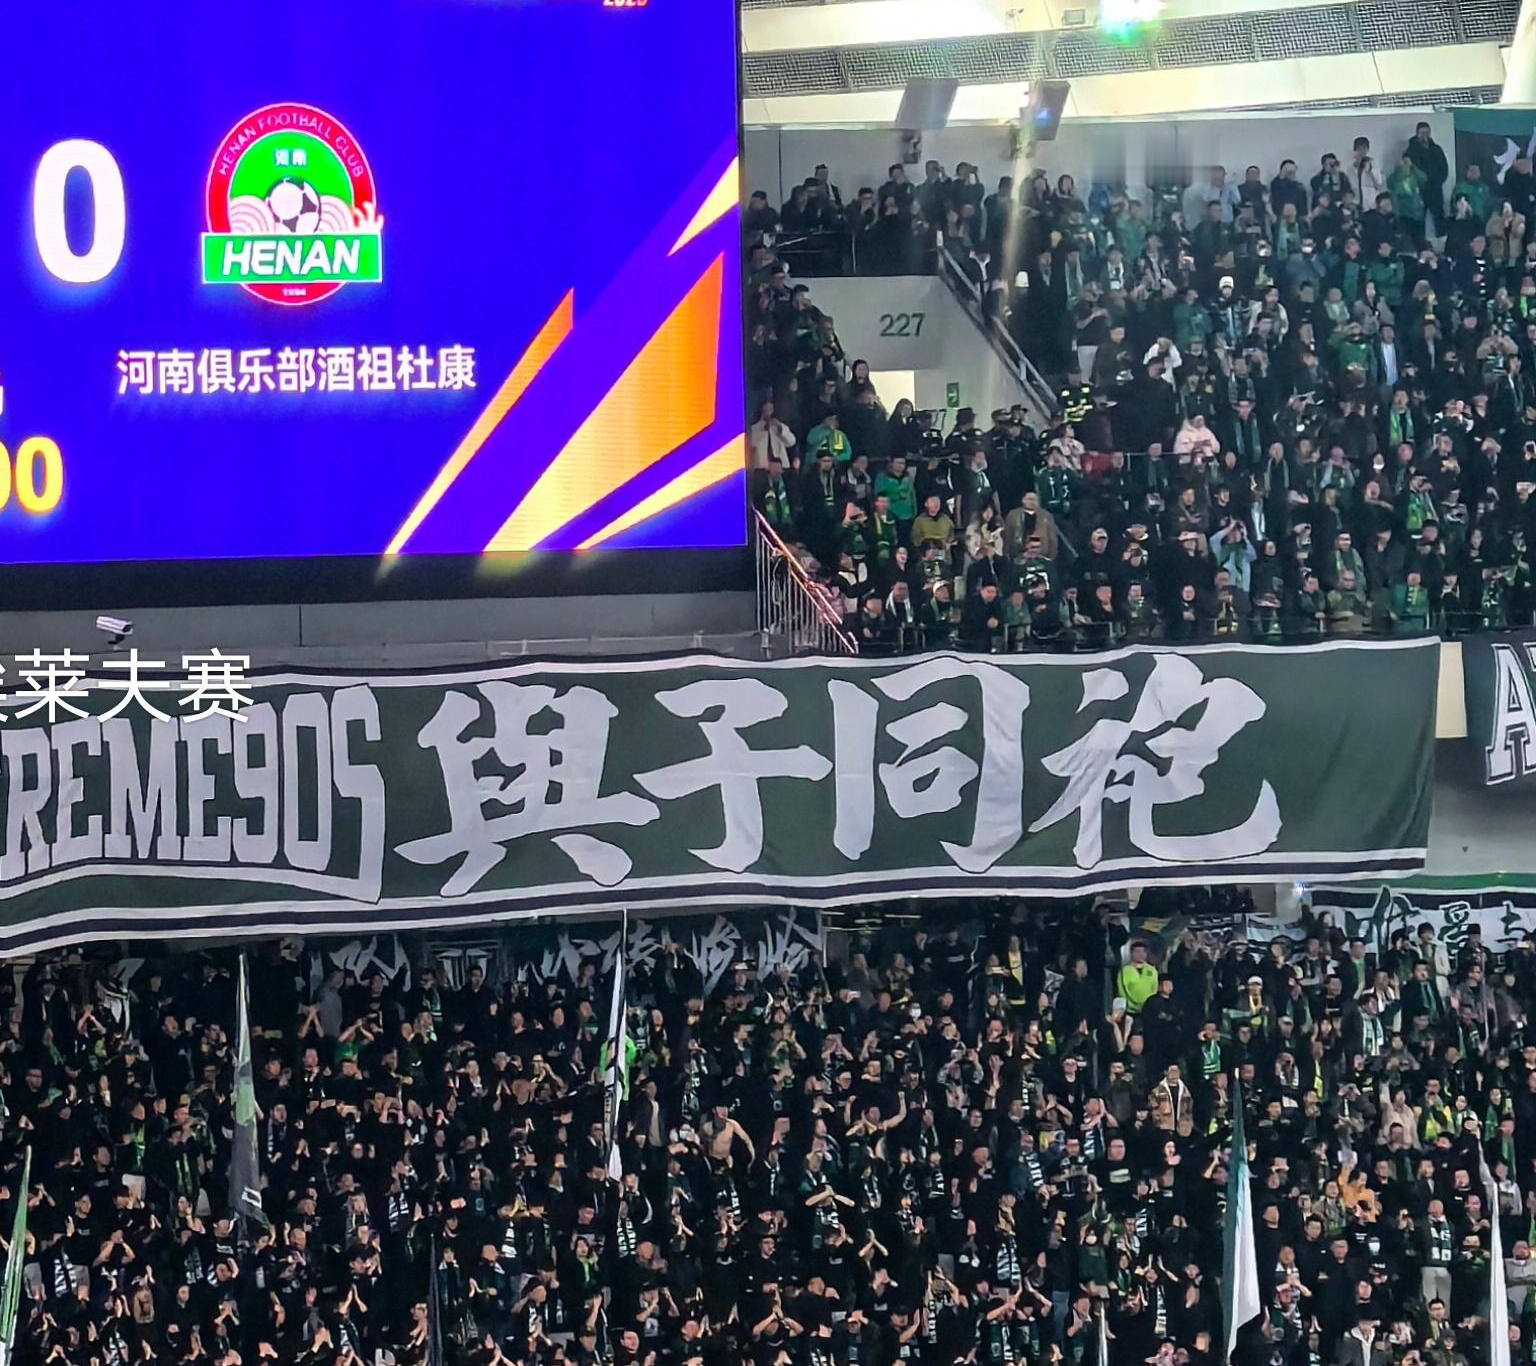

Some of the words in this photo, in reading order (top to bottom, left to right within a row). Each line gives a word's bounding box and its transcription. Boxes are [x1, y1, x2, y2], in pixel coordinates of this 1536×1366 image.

[33, 138, 126, 284] 0
[222, 239, 360, 275] HENAN
[879, 313, 925, 338] 227
[116, 346, 477, 397] 河南俱乐部酒祖杜康
